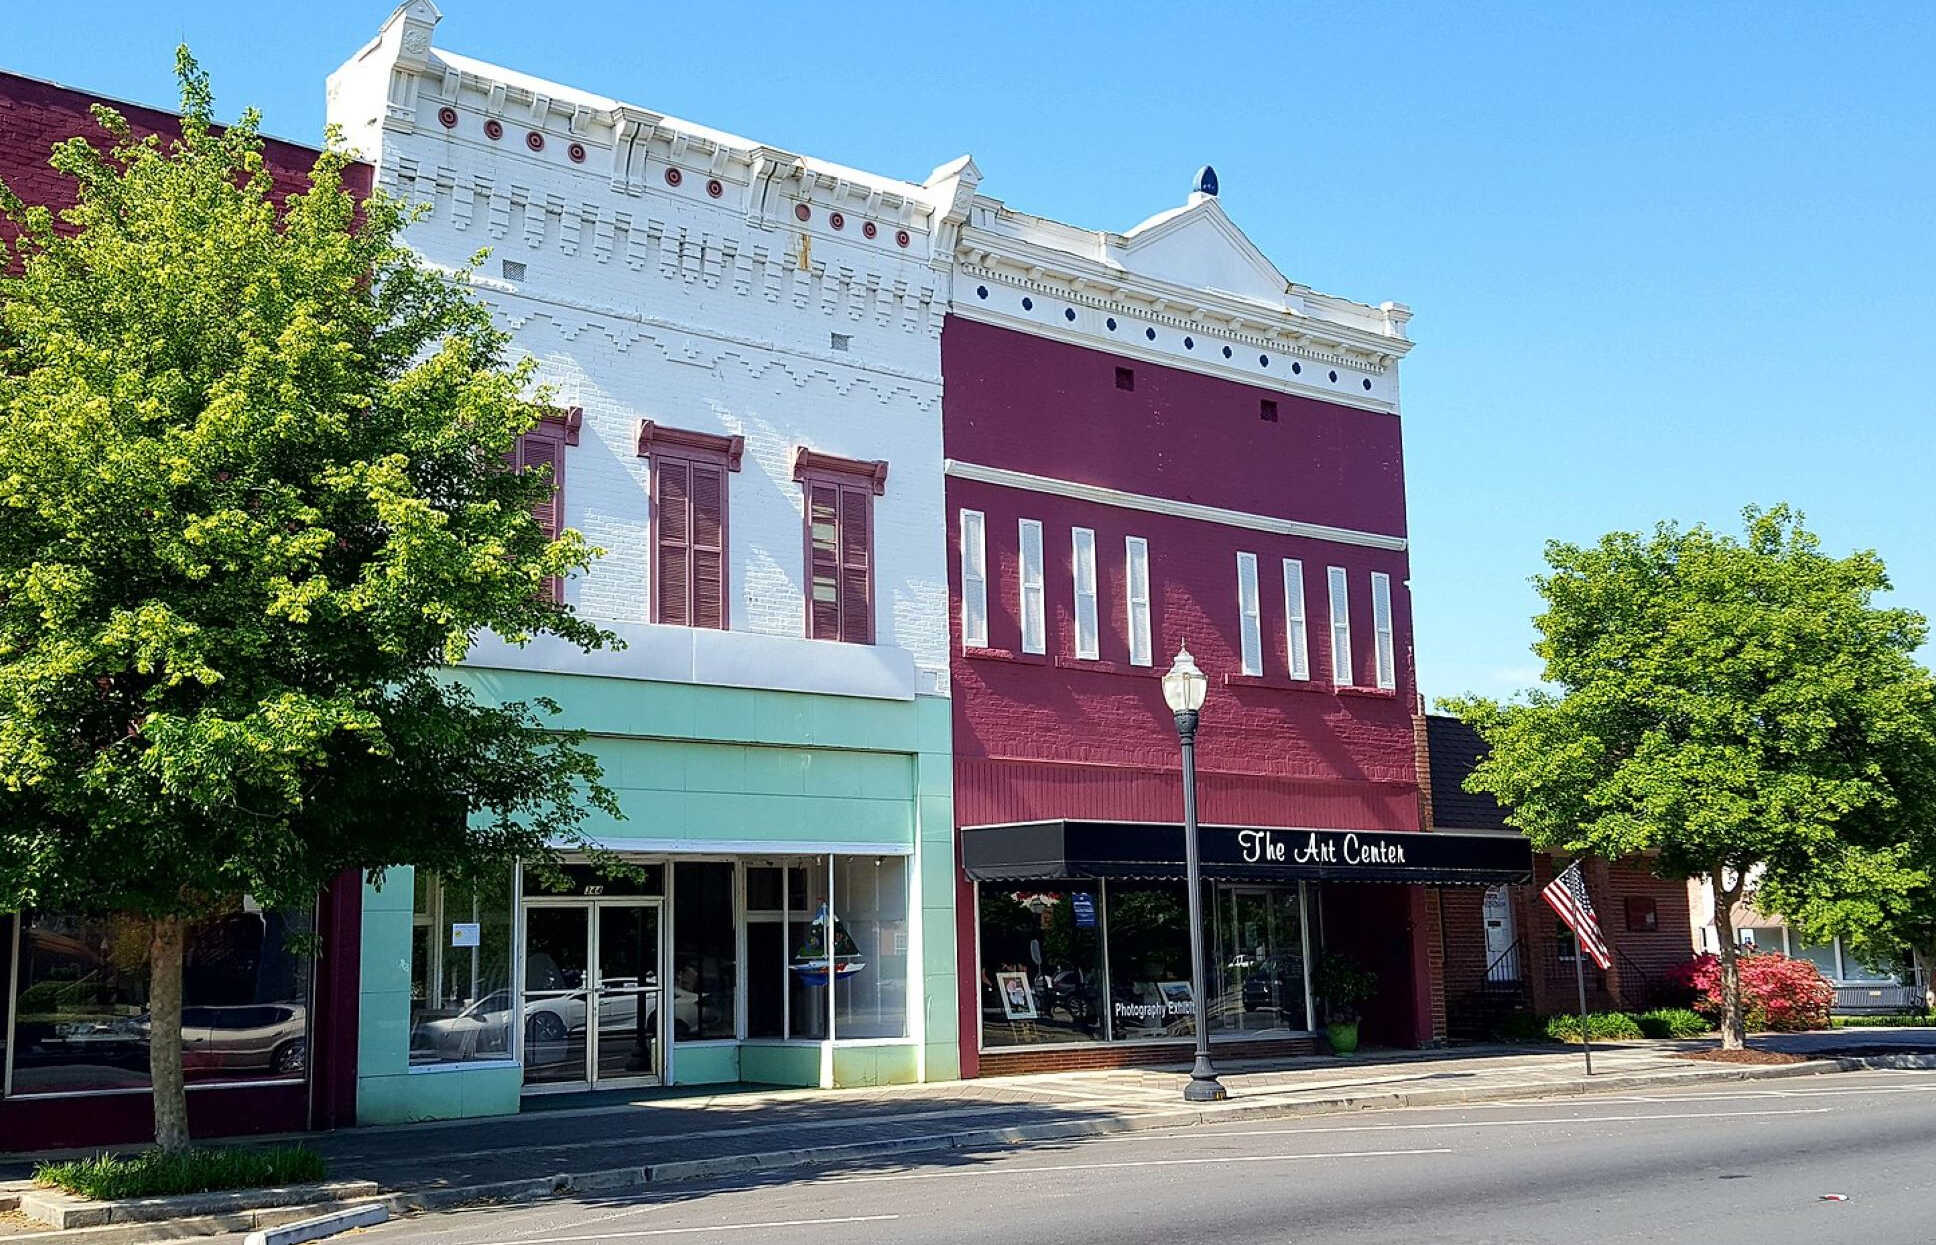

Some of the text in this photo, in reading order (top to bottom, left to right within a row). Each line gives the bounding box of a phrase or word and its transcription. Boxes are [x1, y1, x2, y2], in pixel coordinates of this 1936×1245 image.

[1238, 830, 1406, 865] The Art Center
[1115, 1002, 1166, 1019] Photography
